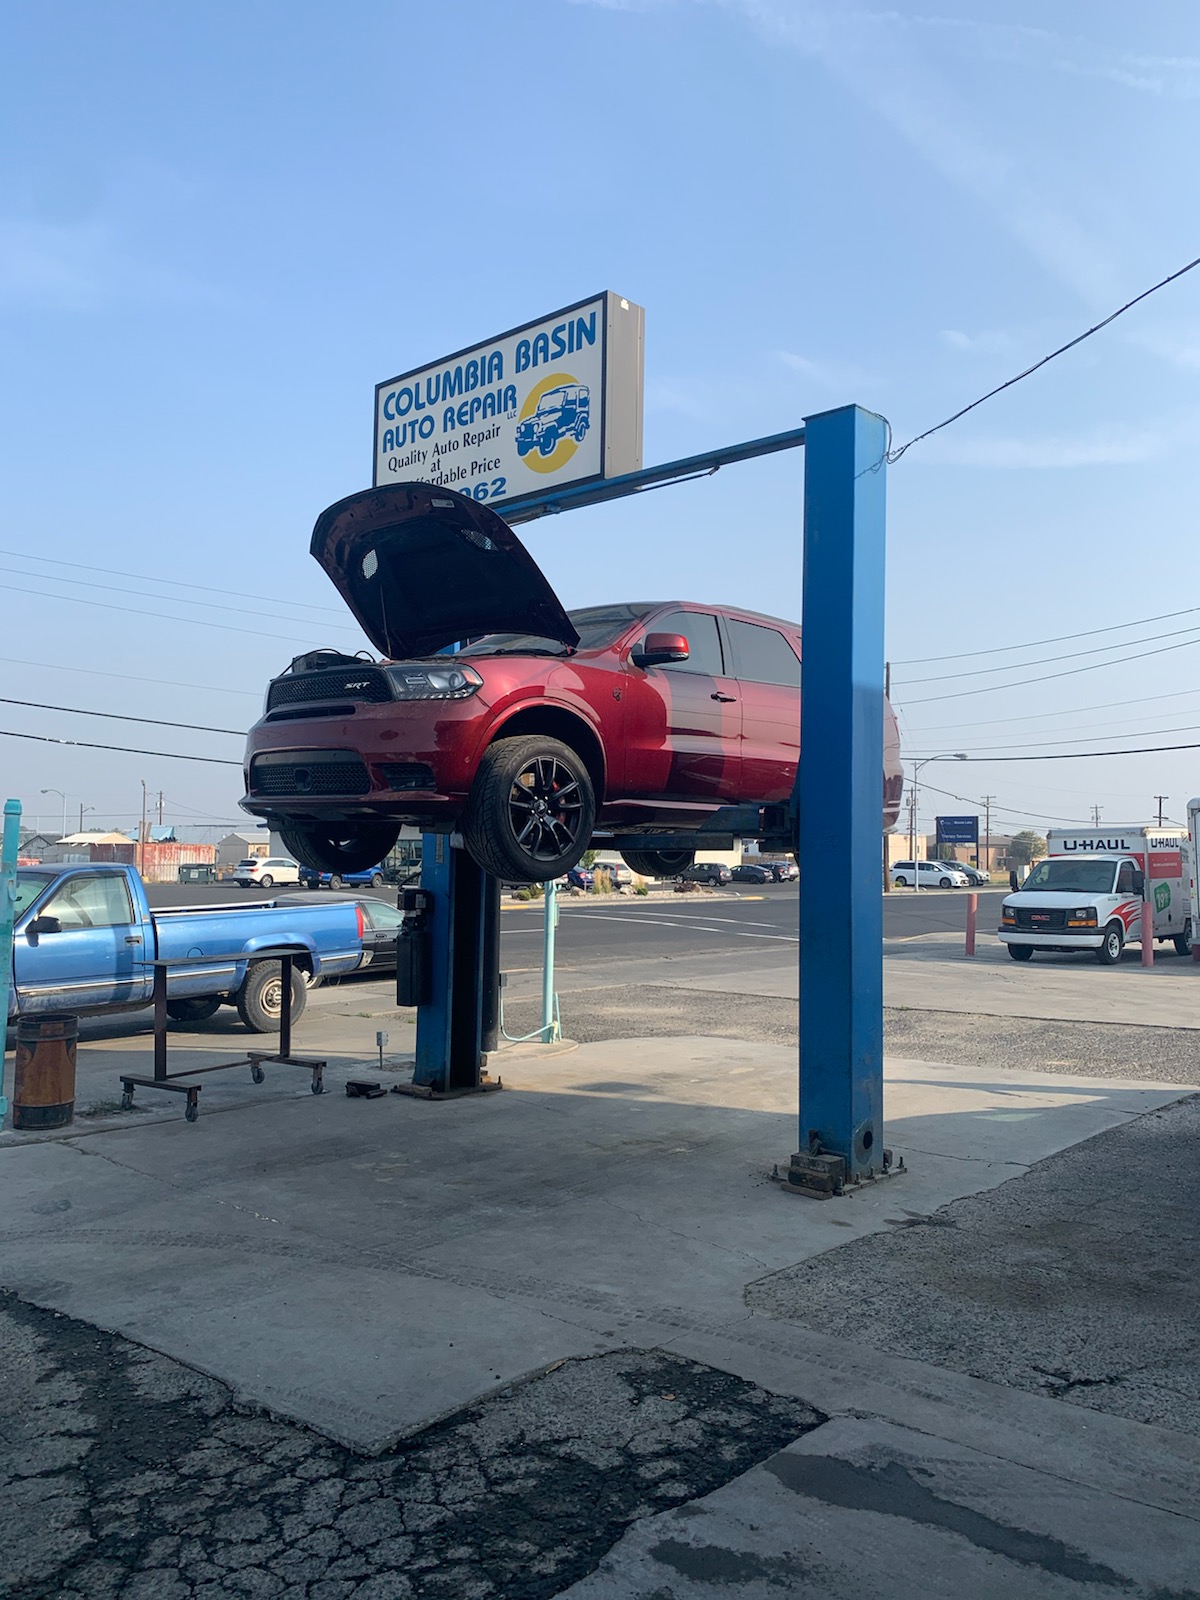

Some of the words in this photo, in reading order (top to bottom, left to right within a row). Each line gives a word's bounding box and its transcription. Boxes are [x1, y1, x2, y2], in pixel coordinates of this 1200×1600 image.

[383, 350, 503, 421] COLUMBIA
[515, 311, 597, 374] BASIN
[382, 414, 435, 454] AUTO
[443, 384, 517, 433] REPAIR
[507, 409, 517, 420] LLC
[388, 449, 429, 473] Quality
[432, 439, 459, 458] Auto
[463, 423, 501, 448] Repair
[430, 458, 441, 473] at
[470, 457, 501, 476] Price
[344, 681, 370, 690] SRT
[1063, 839, 1131, 850] U-HAUL
[1151, 837, 1179, 848] U-HAUL
